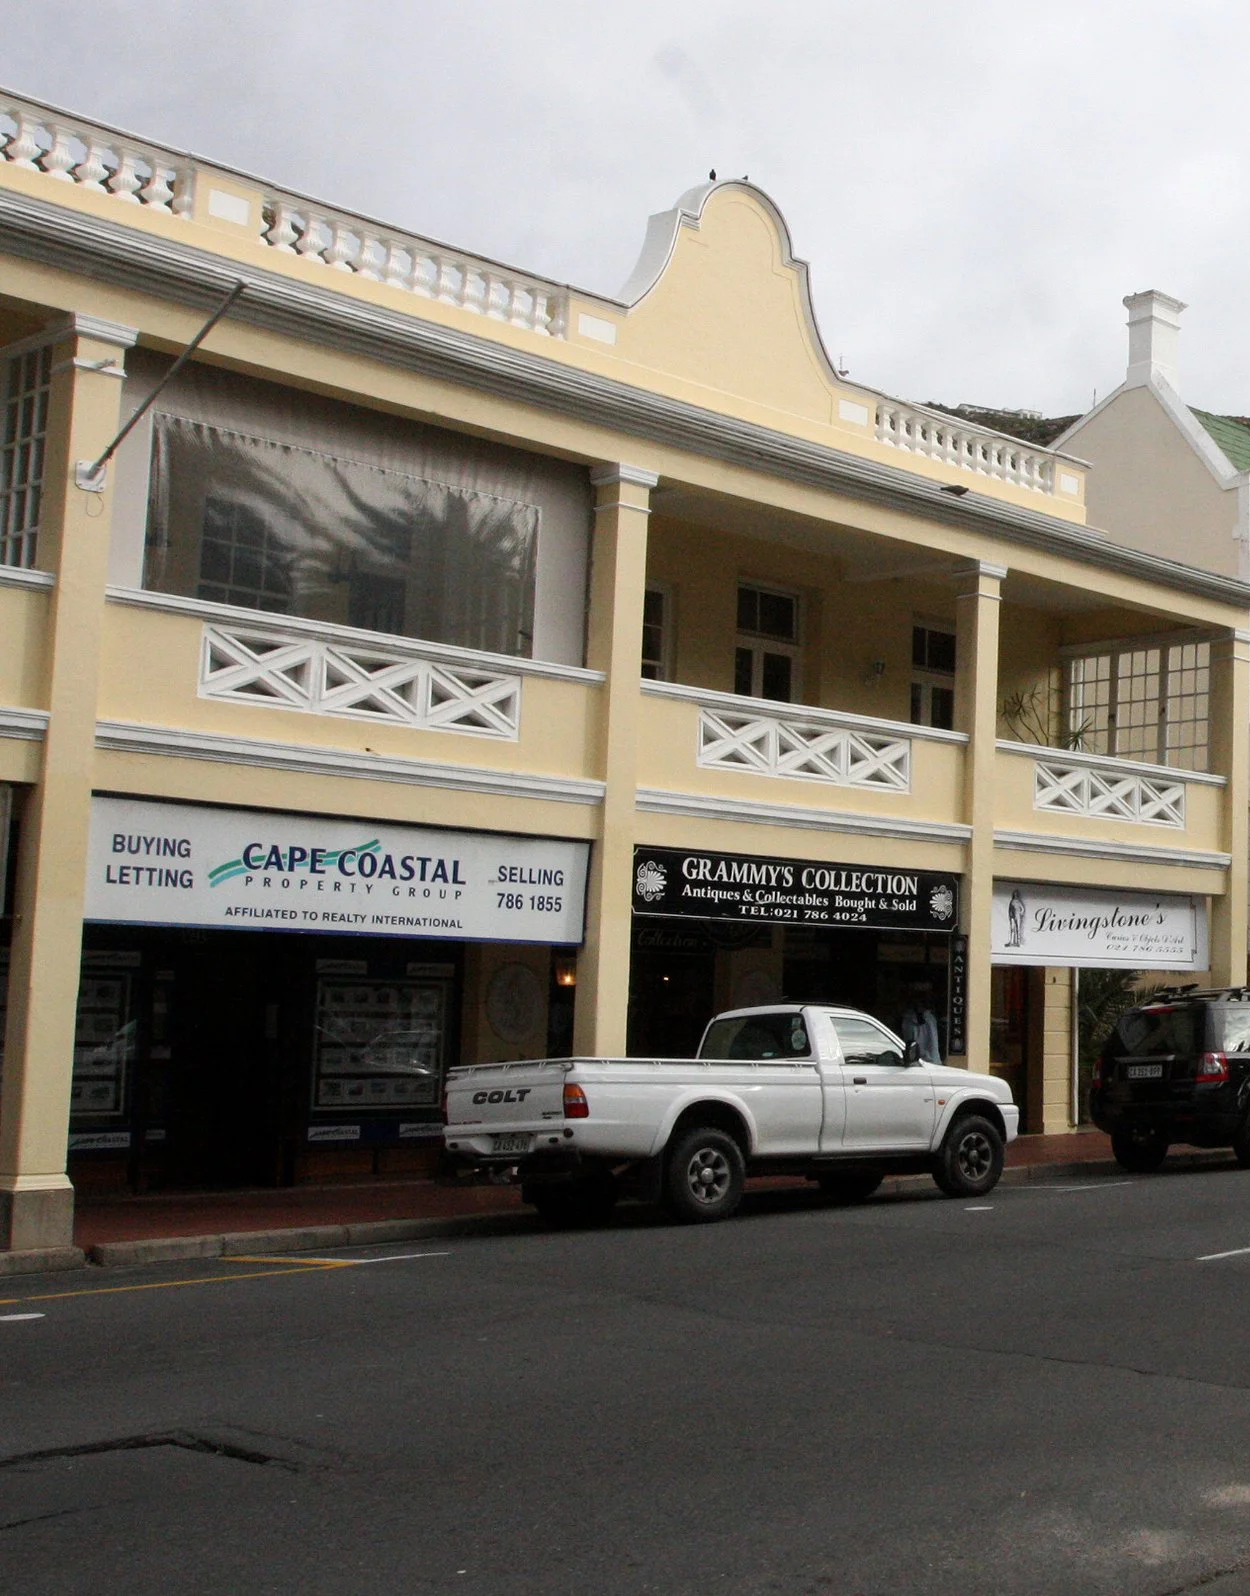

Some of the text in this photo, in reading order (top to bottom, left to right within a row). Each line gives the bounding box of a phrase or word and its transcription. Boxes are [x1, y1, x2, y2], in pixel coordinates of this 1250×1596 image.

[112, 834, 191, 858] BUYING
[242, 842, 466, 886] CAPE COASTAL
[497, 865, 565, 886] SELLING
[106, 865, 193, 889] LETTING
[245, 876, 463, 900] PROPERTY GROUP
[681, 857, 918, 896] GRAMMY'S COLLECTION
[496, 892, 563, 913] 786 1855
[681, 884, 917, 912] Antiques & Collectables Bought & Sold
[225, 907, 463, 929] AFFILIATED TO REALTY INTERNATIONAL
[738, 905, 867, 923] TEL:021 786 4024
[1031, 903, 1167, 939] Livingstone's
[953, 955, 964, 1035] ANTIQUES
[472, 1089, 531, 1104] COLT
